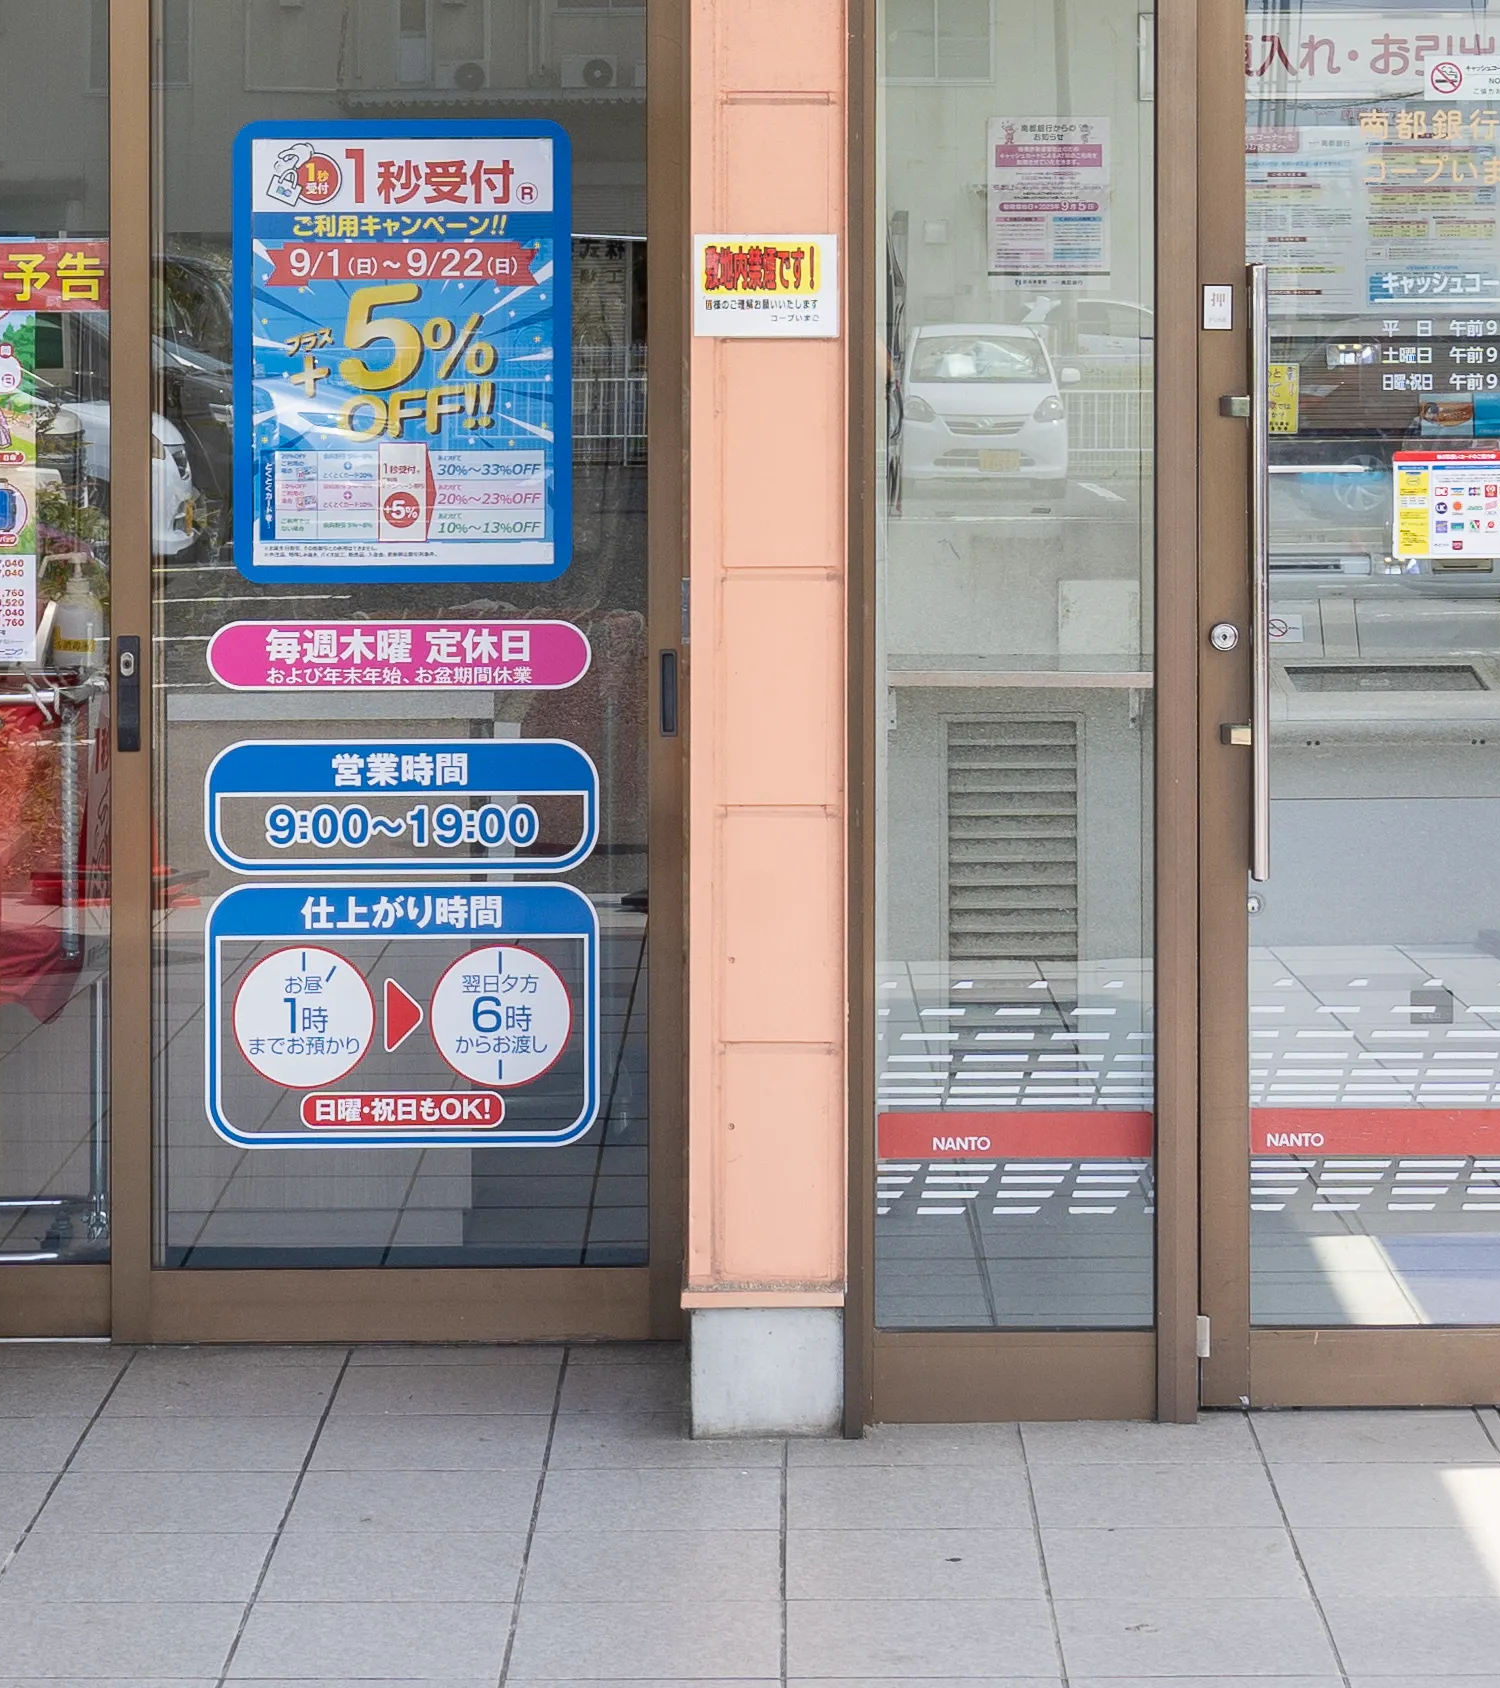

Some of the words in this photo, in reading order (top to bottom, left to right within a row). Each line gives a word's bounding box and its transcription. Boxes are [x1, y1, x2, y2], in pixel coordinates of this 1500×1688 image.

[1033, 133, 1064, 141] お知らせ
[346, 148, 514, 205] 1秒受付
[306, 182, 329, 195] 受付
[293, 215, 507, 237] ご利用キャンペーン!!
[3, 251, 105, 302] 予告
[705, 299, 818, 310] 皆様のご理解お願いいたします
[771, 314, 820, 322] コープいまご
[1382, 347, 1432, 364] 土曜日
[1382, 374, 1432, 391] 日曜・祝日
[266, 629, 412, 665] 毎週木曜
[426, 629, 531, 665] 定休日
[266, 667, 533, 685] および年末年始、お盆期間休業
[332, 753, 469, 787] 営業時間
[301, 896, 502, 930] 仕上がり時間
[284, 975, 322, 995] お昼
[462, 975, 538, 995] 翌日夕方
[283, 997, 328, 1034] 1時
[471, 997, 531, 1035] 6時
[248, 1037, 360, 1056] までお預かり
[455, 1035, 547, 1056] からお渡し
[932, 1136, 991, 1150] NANTO
[1266, 1133, 1324, 1147] NANTO
